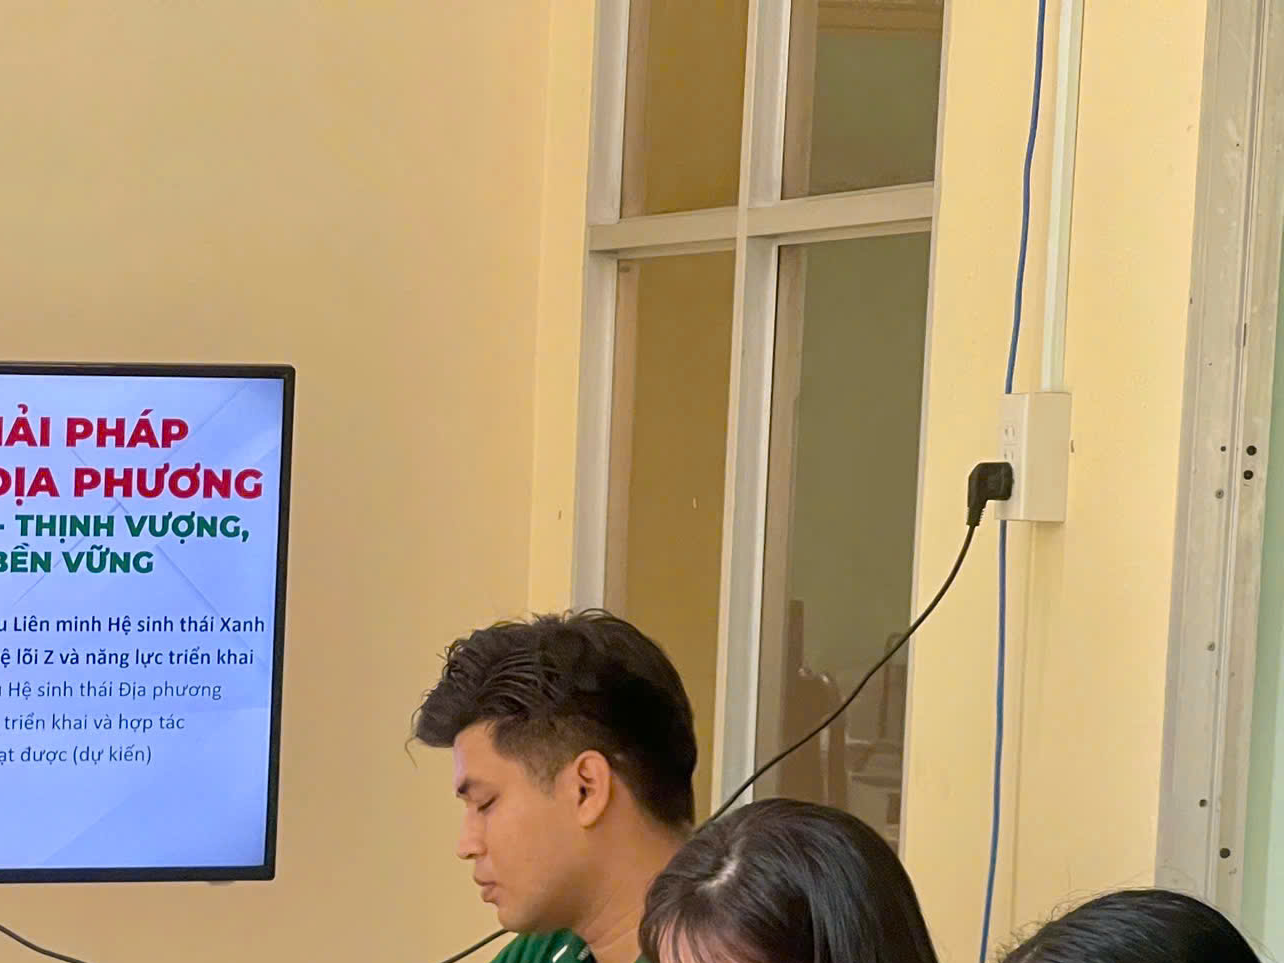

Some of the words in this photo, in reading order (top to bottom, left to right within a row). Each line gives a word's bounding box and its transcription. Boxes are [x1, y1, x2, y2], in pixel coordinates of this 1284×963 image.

[66, 409, 188, 448] PHÁP
[74, 462, 263, 499] PHƯƠNG
[15, 514, 114, 544] THỊNH
[124, 509, 249, 544] VƯỢNG,
[61, 544, 153, 573] VỮNG
[14, 615, 49, 632] Liên
[56, 616, 101, 632] minh
[108, 615, 131, 635] Hệ
[137, 616, 173, 632] sinh
[180, 616, 214, 632] thái
[220, 616, 264, 632] Xanh
[17, 648, 38, 665] lõi
[44, 650, 54, 664] Z
[60, 648, 79, 664] và
[86, 648, 129, 668] năng
[136, 648, 163, 668] lực
[169, 646, 210, 665] triển
[217, 649, 253, 664] khai
[9, 681, 31, 700] Hệ
[38, 681, 72, 697] sinh
[80, 680, 112, 696] thái
[119, 682, 145, 700] Địa
[153, 681, 221, 700] phương
[5, 712, 45, 730] triển
[52, 713, 87, 730] khai
[94, 714, 111, 729] và
[119, 713, 152, 733] hợp
[159, 714, 184, 729] tác
[21, 746, 67, 765] được
[73, 746, 104, 765] (dự
[110, 744, 151, 765] kiến)
